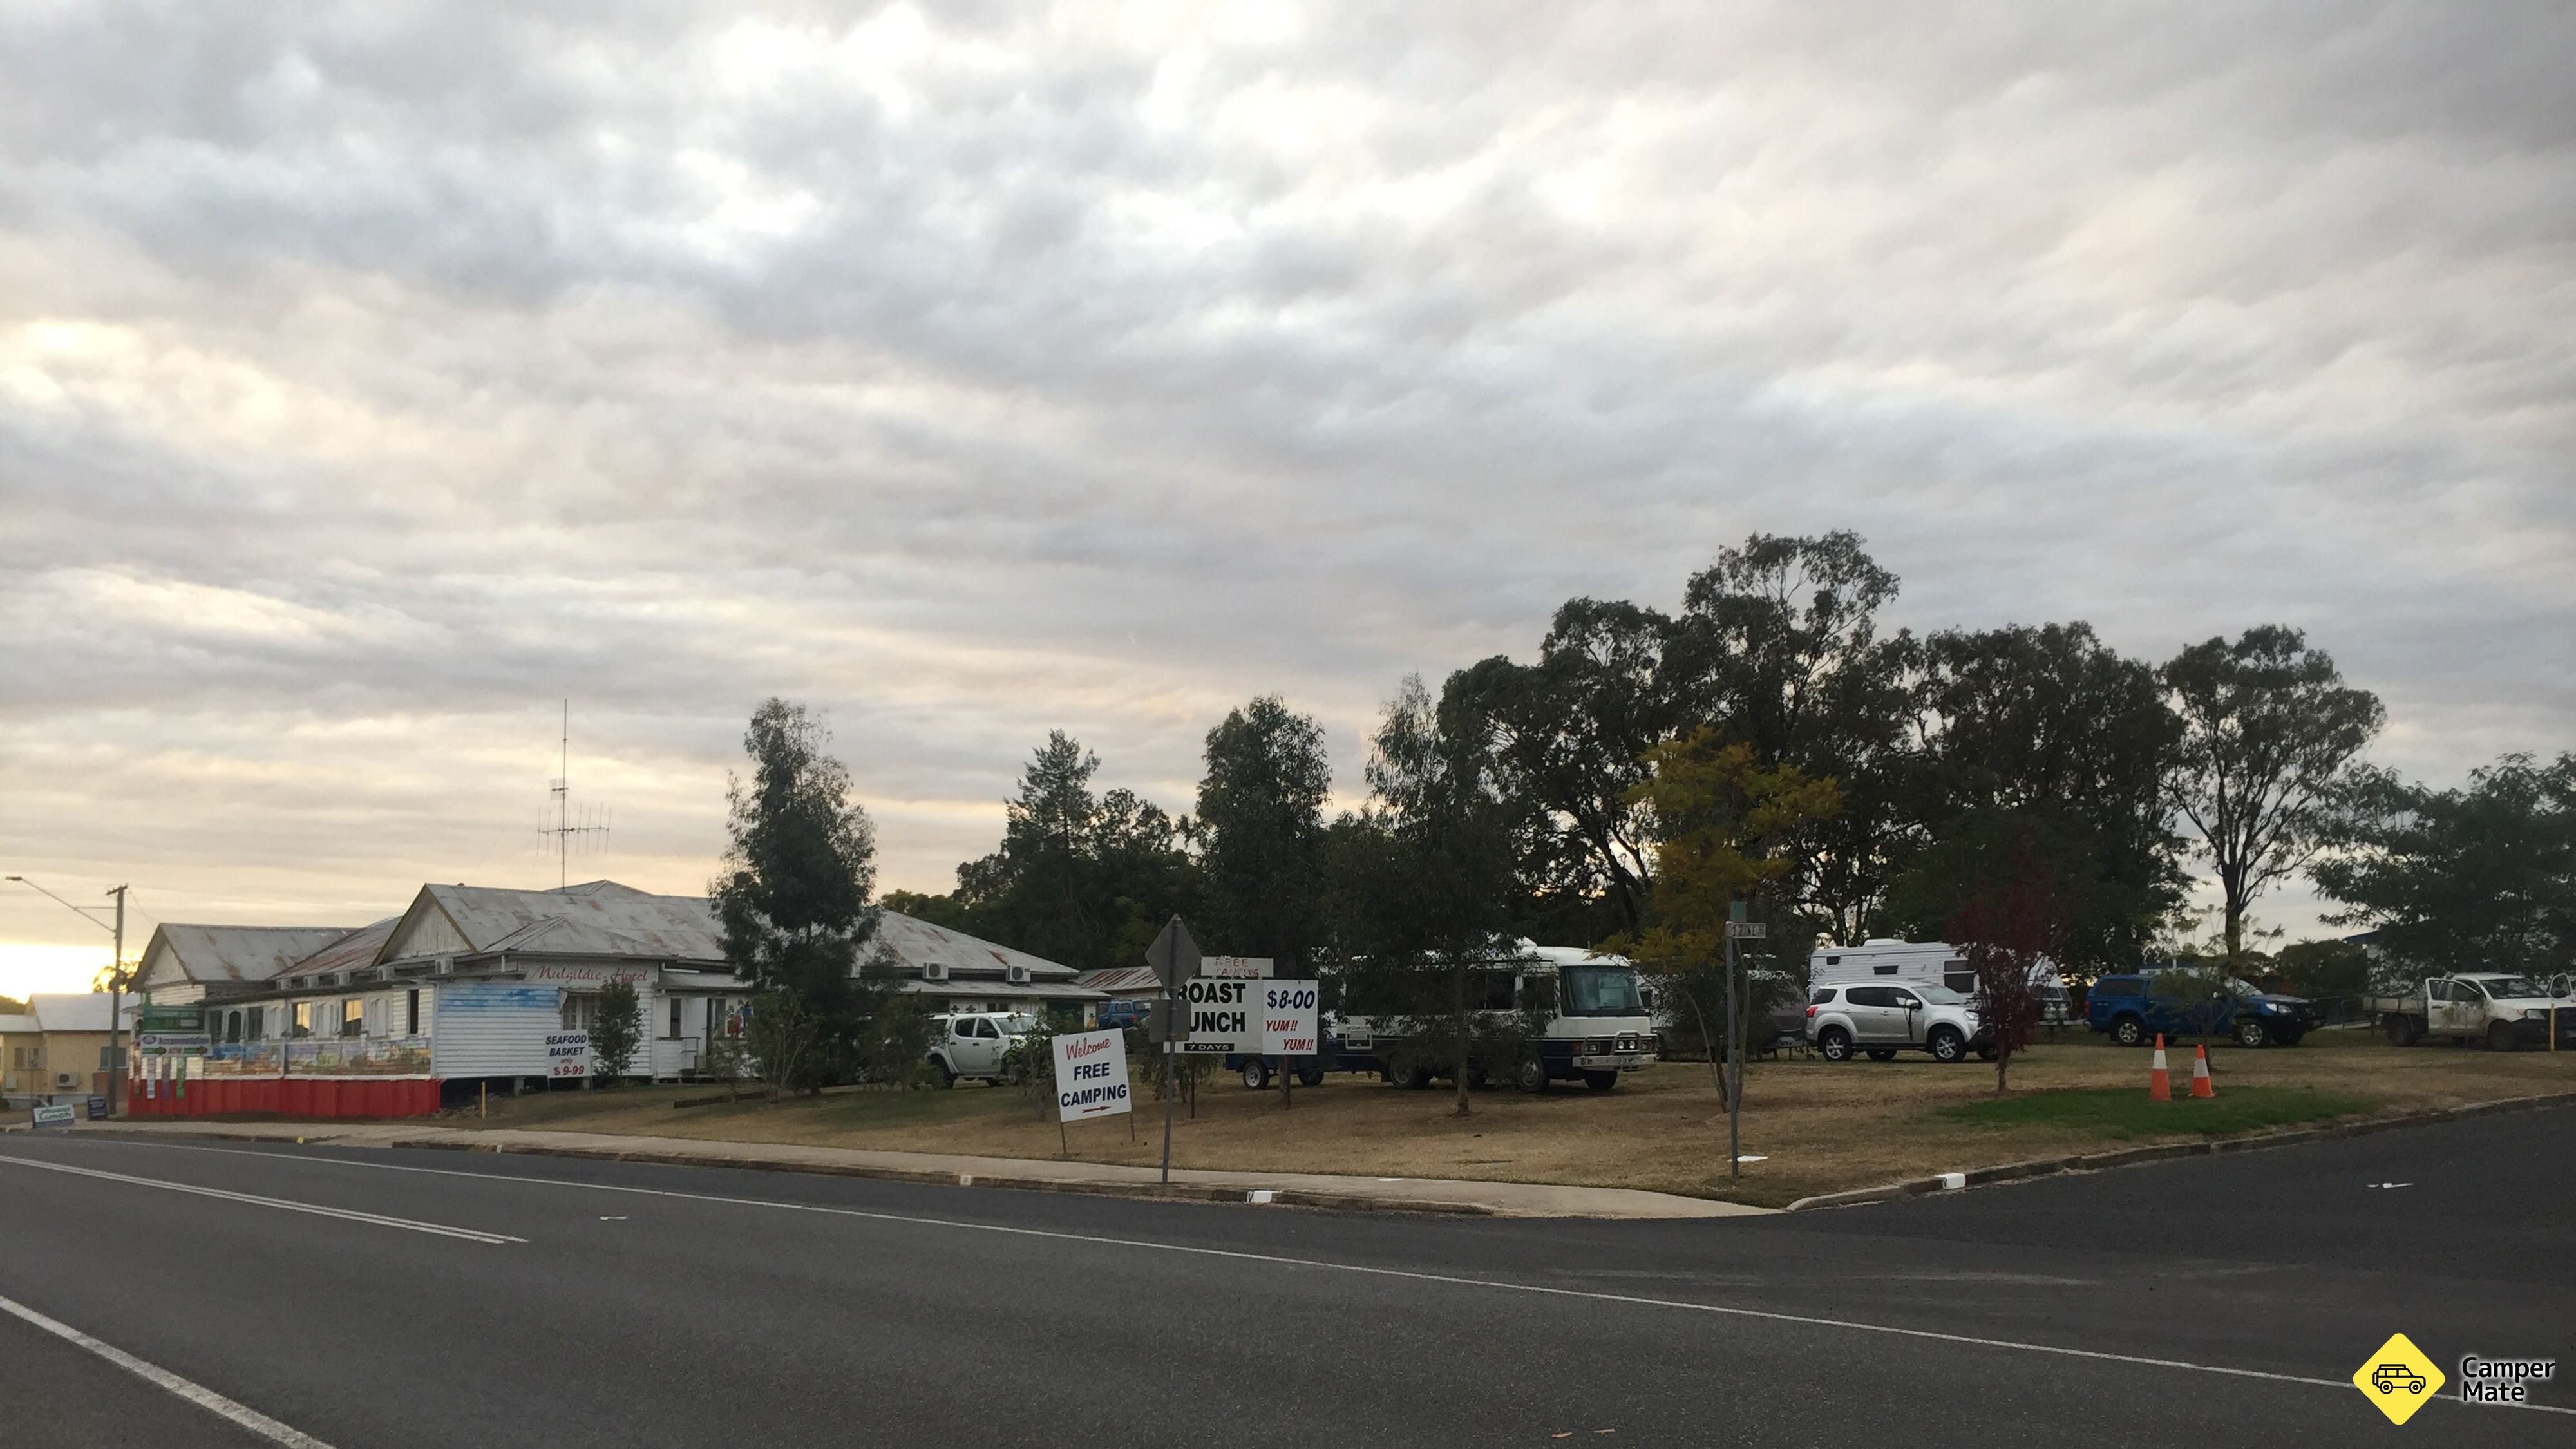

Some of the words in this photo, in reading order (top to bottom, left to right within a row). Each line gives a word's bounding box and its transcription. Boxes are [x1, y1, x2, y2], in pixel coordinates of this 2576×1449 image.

[611, 967, 648, 982] Hotel
[1190, 1011, 1245, 1032] UNCH
[1265, 1020, 1298, 1032] YUM!!
[545, 1034, 587, 1045] SEAFOOD
[1283, 1039, 1314, 1051] YUM!!
[549, 1046, 585, 1057] BASKET
[1066, 1037, 1112, 1060] Welcome
[1074, 1062, 1110, 1081] FREE
[1061, 1084, 1127, 1107] CAMPING
